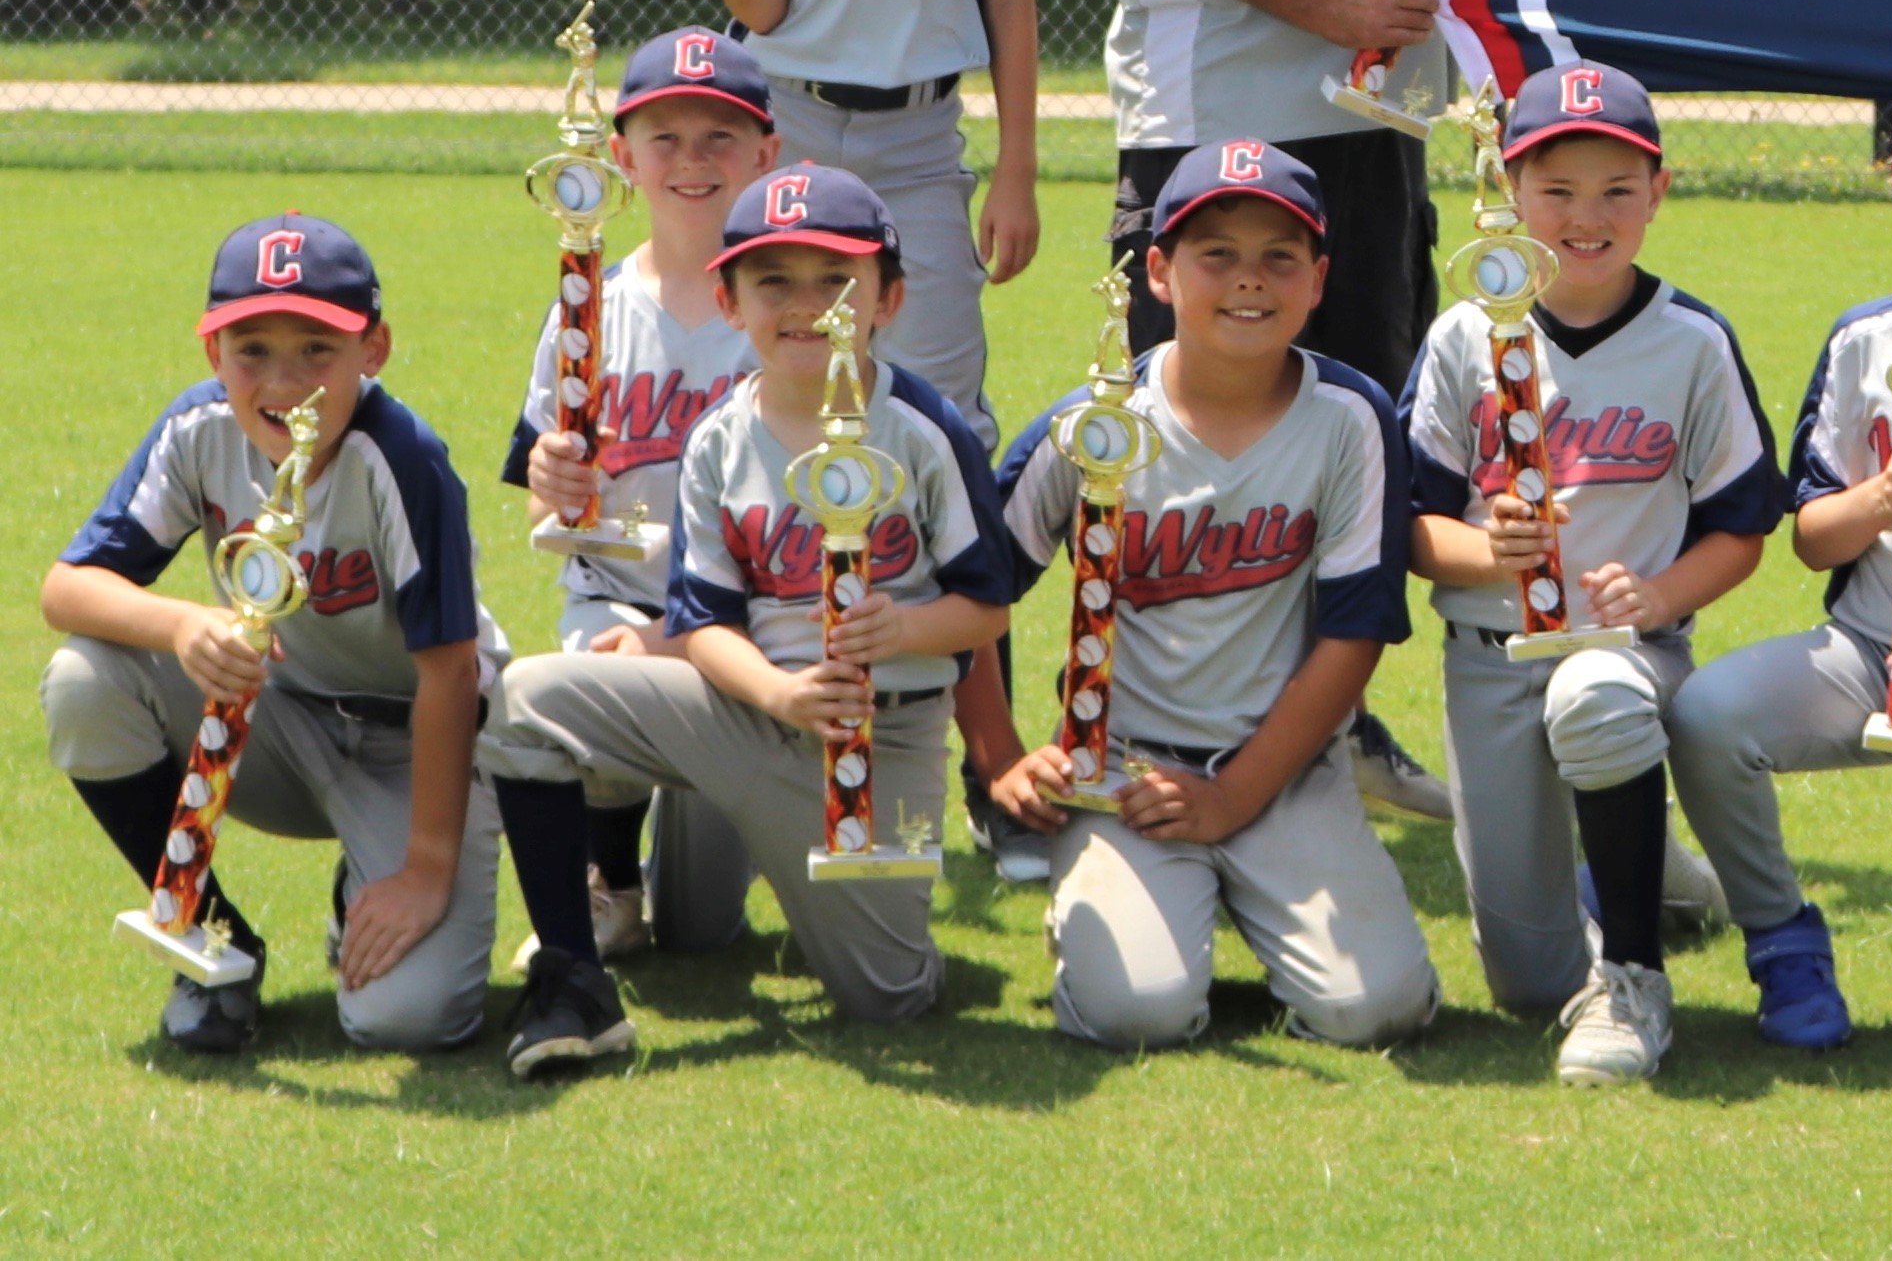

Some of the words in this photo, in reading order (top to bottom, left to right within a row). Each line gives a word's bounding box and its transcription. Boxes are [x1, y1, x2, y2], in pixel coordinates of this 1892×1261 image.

[674, 33, 715, 79] C
[1561, 68, 1603, 115] C
[1220, 139, 1265, 184] C
[764, 175, 809, 226] C
[257, 231, 303, 287] C
[720, 503, 918, 582] Wye
[1124, 503, 1317, 580] Wylie
